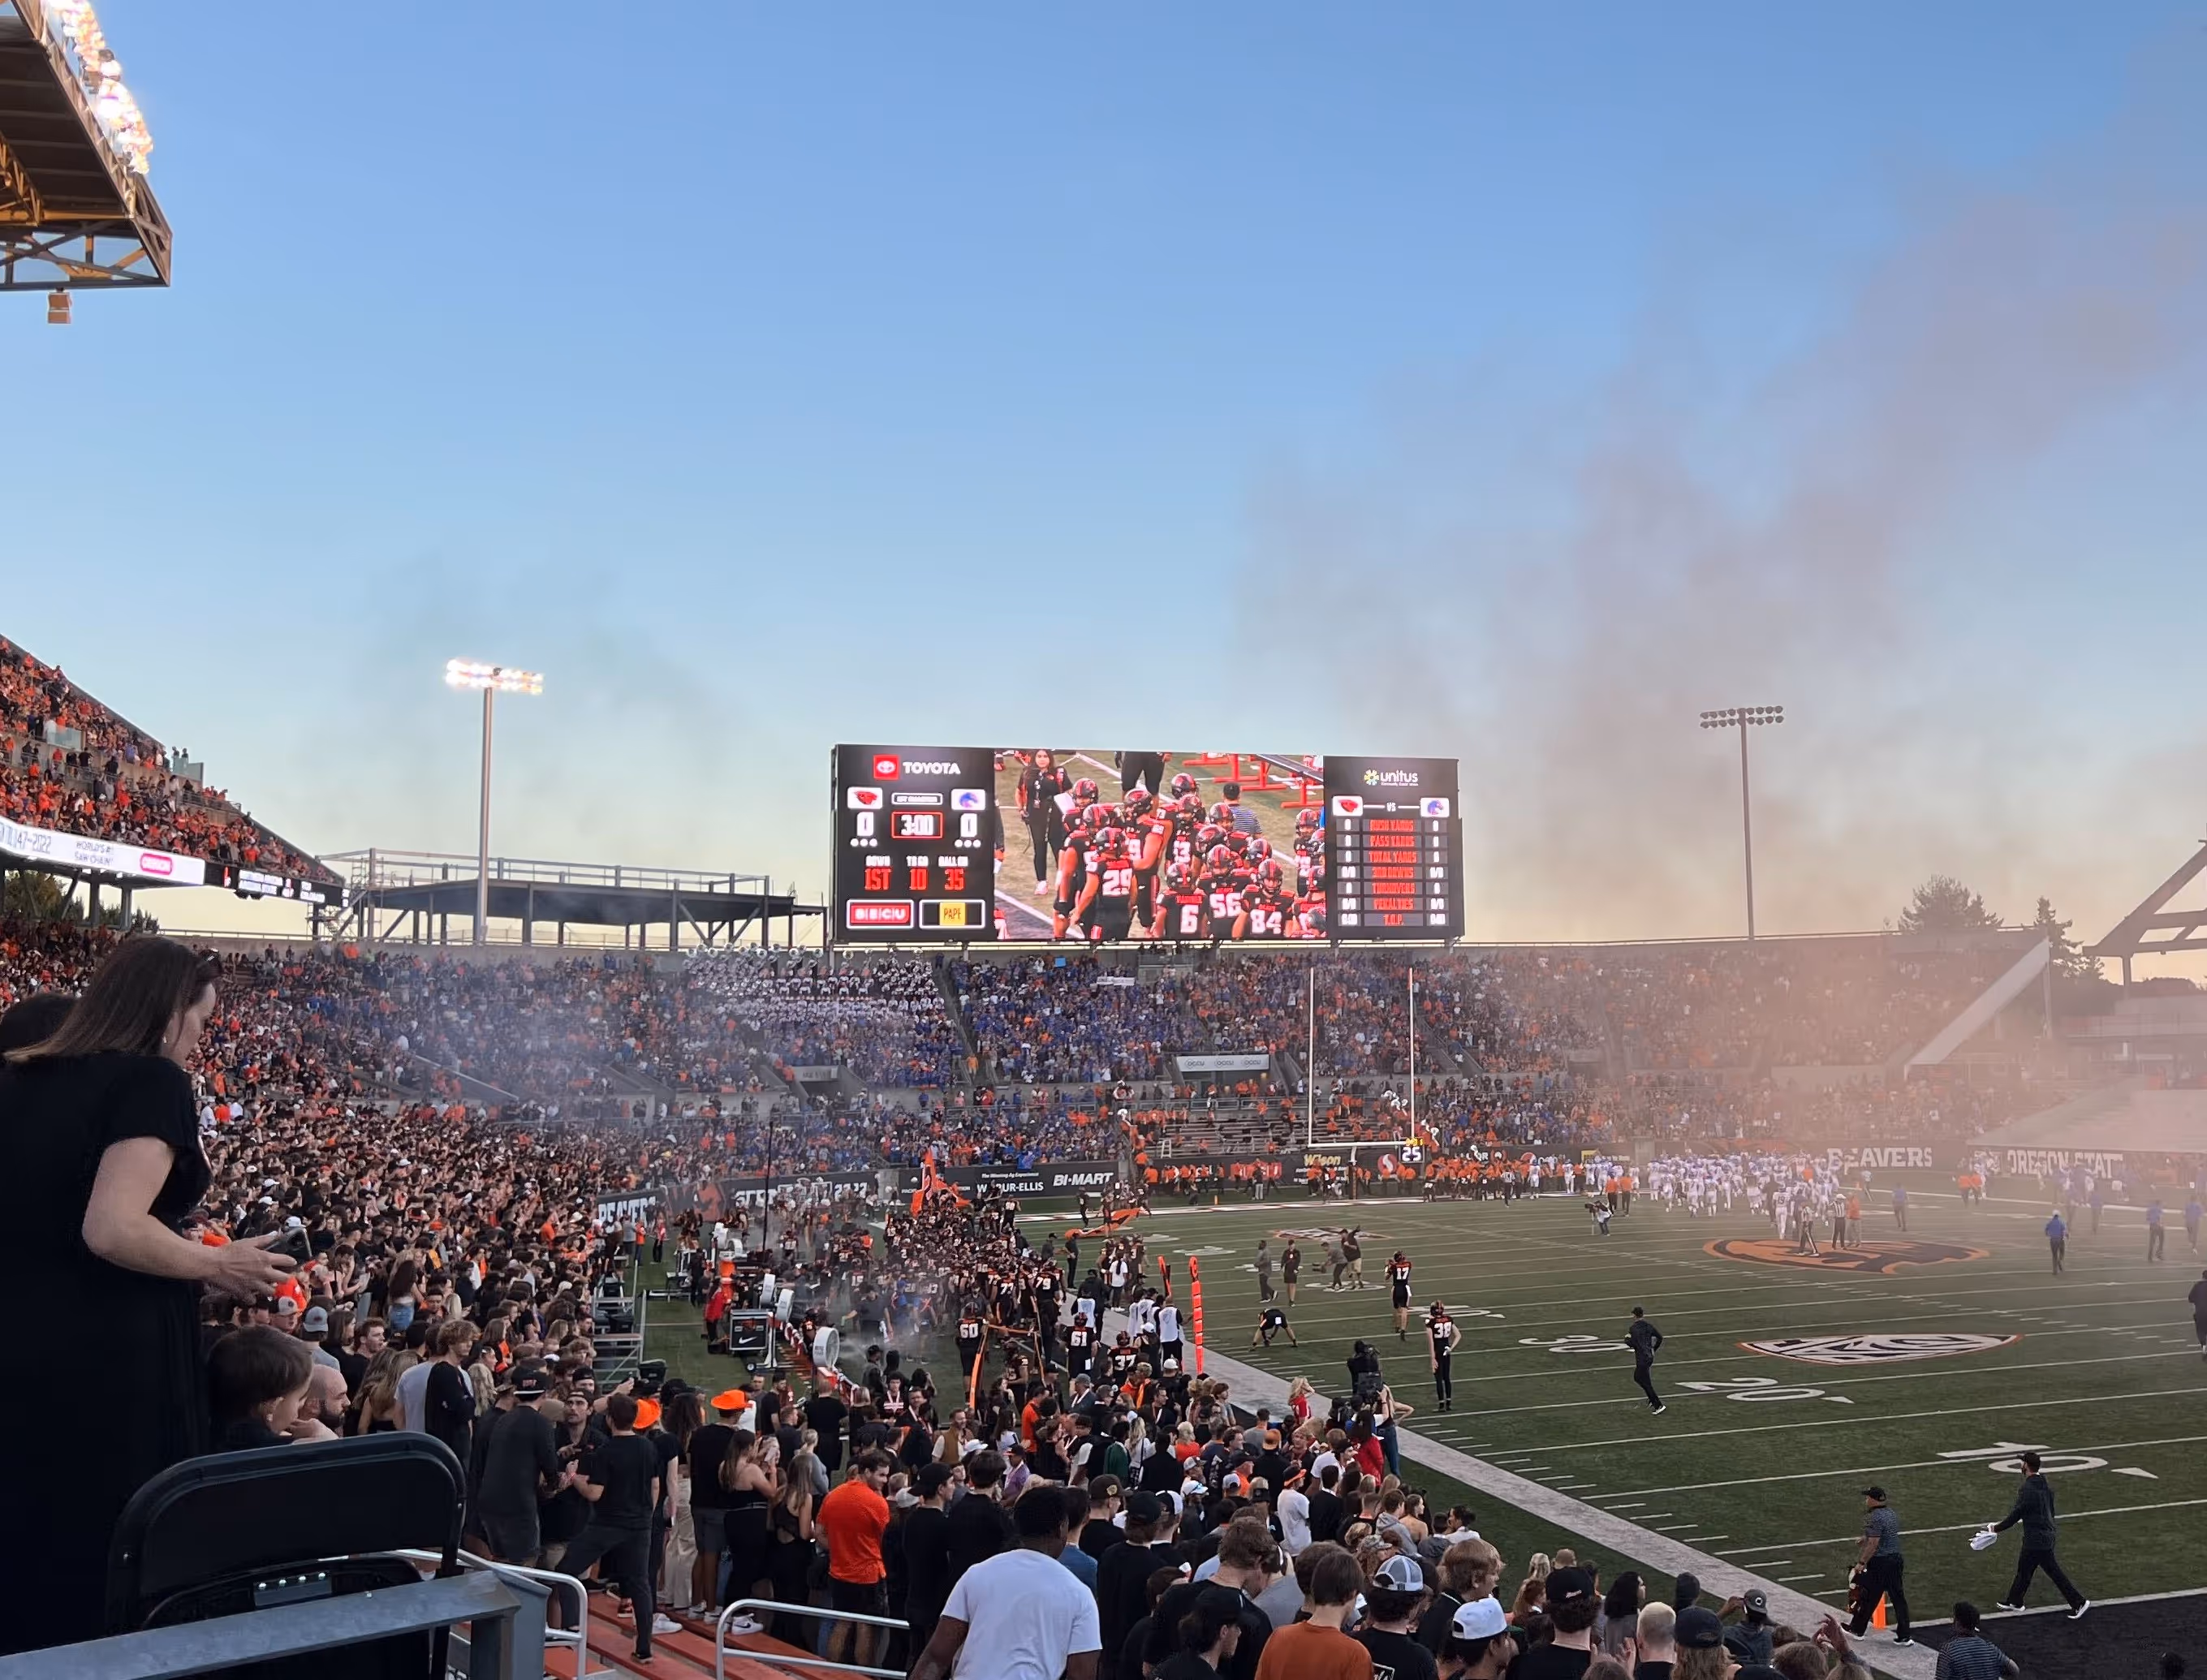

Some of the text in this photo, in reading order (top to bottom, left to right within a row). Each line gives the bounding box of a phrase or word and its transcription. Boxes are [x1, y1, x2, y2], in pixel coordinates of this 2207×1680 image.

[903, 761, 961, 774] TOYOTA
[1380, 769, 1419, 783] unitus
[856, 812, 874, 837] 0
[960, 812, 977, 838] 0
[864, 868, 891, 890] 1ST
[944, 868, 964, 890] 35
[1102, 868, 1132, 896] 29
[1209, 893, 1242, 918] 56
[1180, 904, 1199, 933] 6
[1250, 909, 1282, 934] 84
[1304, 1153, 1342, 1166] Wilson
[1402, 1146, 1421, 1161] 25
[1827, 1147, 1933, 1170] BEAVERS
[2007, 1149, 2071, 1176] OREGON
[1035, 1276, 1051, 1290] 79
[1396, 1266, 1410, 1280] 17
[959, 1323, 979, 1338] 60
[1071, 1331, 1088, 1346] 61
[1433, 1322, 1452, 1338] 38
[1114, 1355, 1136, 1370] 37
[1676, 1377, 1826, 1402] 20
[1937, 1441, 2109, 1473] 10
